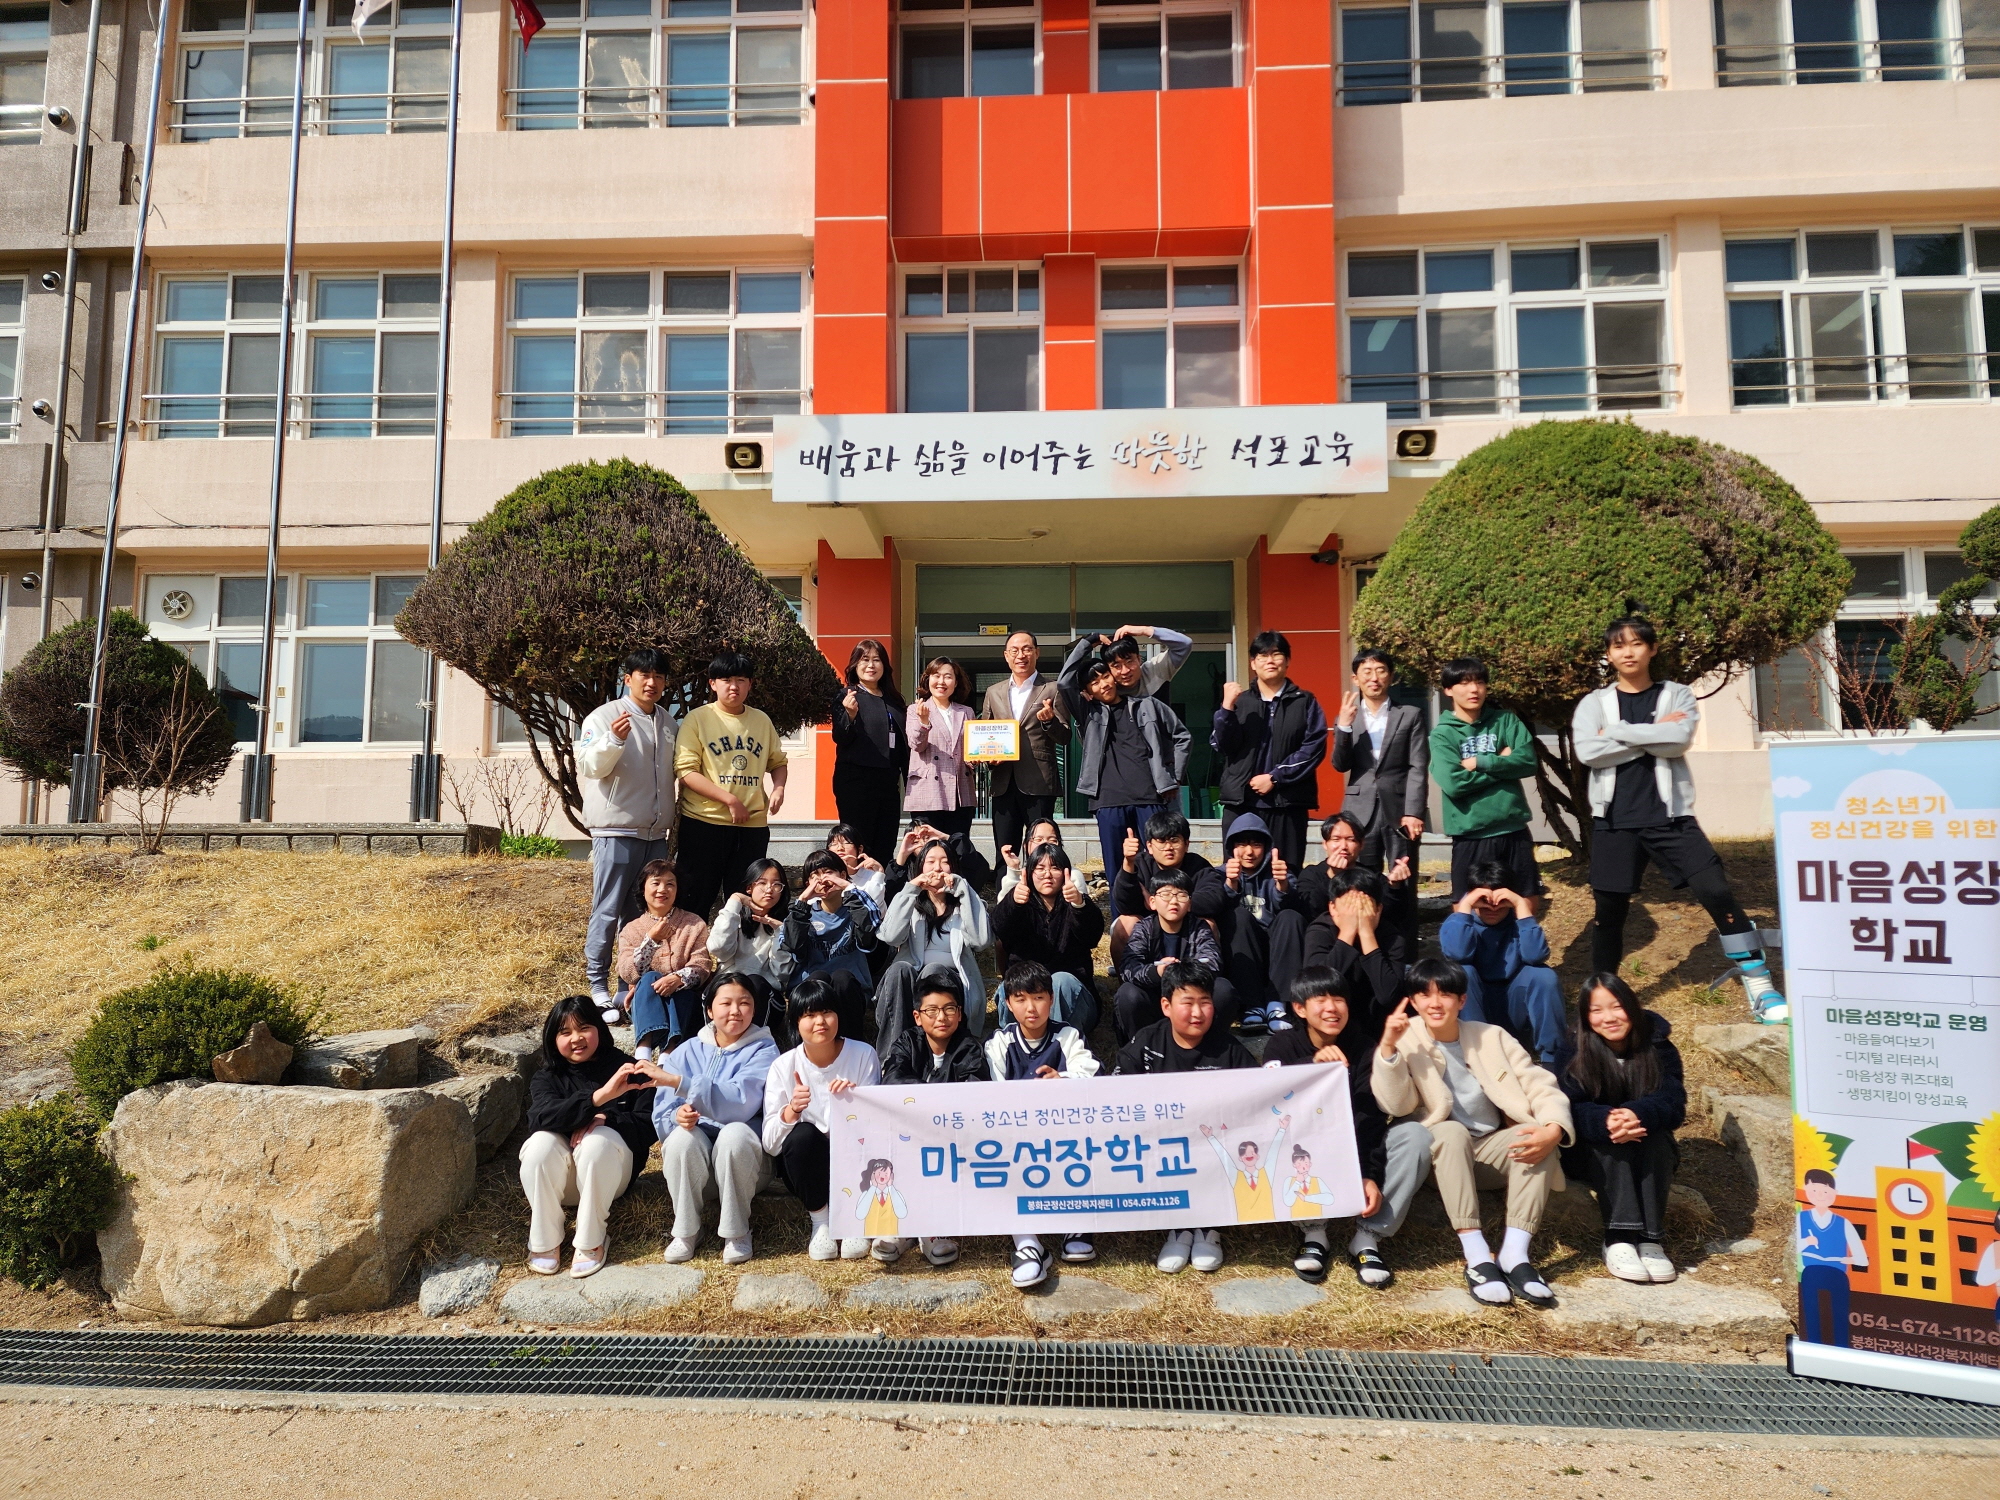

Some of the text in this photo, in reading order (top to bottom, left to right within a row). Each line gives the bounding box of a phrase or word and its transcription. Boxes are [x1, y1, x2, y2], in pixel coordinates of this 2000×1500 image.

[800, 439, 900, 478] 배움과
[914, 440, 967, 476] 삶을
[983, 440, 1095, 472] 이어주는
[1109, 430, 1206, 471] 따뜻한
[708, 735, 763, 759] CHASE
[1846, 796, 1947, 815] 청소년기
[1810, 819, 1998, 839] 정신건강을 위한
[1797, 860, 2000, 906] 마음성장
[1850, 917, 1953, 965] 학교
[1826, 1008, 1988, 1032] 마음성장학교 운영
[1844, 1033, 1935, 1049] 마음들여다보기
[1845, 1051, 1939, 1068] 디지털 리터러시
[1846, 1069, 1954, 1089] 마음성장 퀴즈대회
[1846, 1087, 1968, 1109] 생명지킴이 양성교육
[932, 1102, 1187, 1130] 아동 청소년 정신건강증진을 위한
[921, 1134, 1198, 1189] 마음성장학교
[1027, 1196, 1180, 1211] 봉화군정신건강복지센터 054.674.1126
[1849, 1312, 2000, 1346] 054-674-1126
[1851, 1335, 2000, 1369] 봉화군정신건강복지센터
